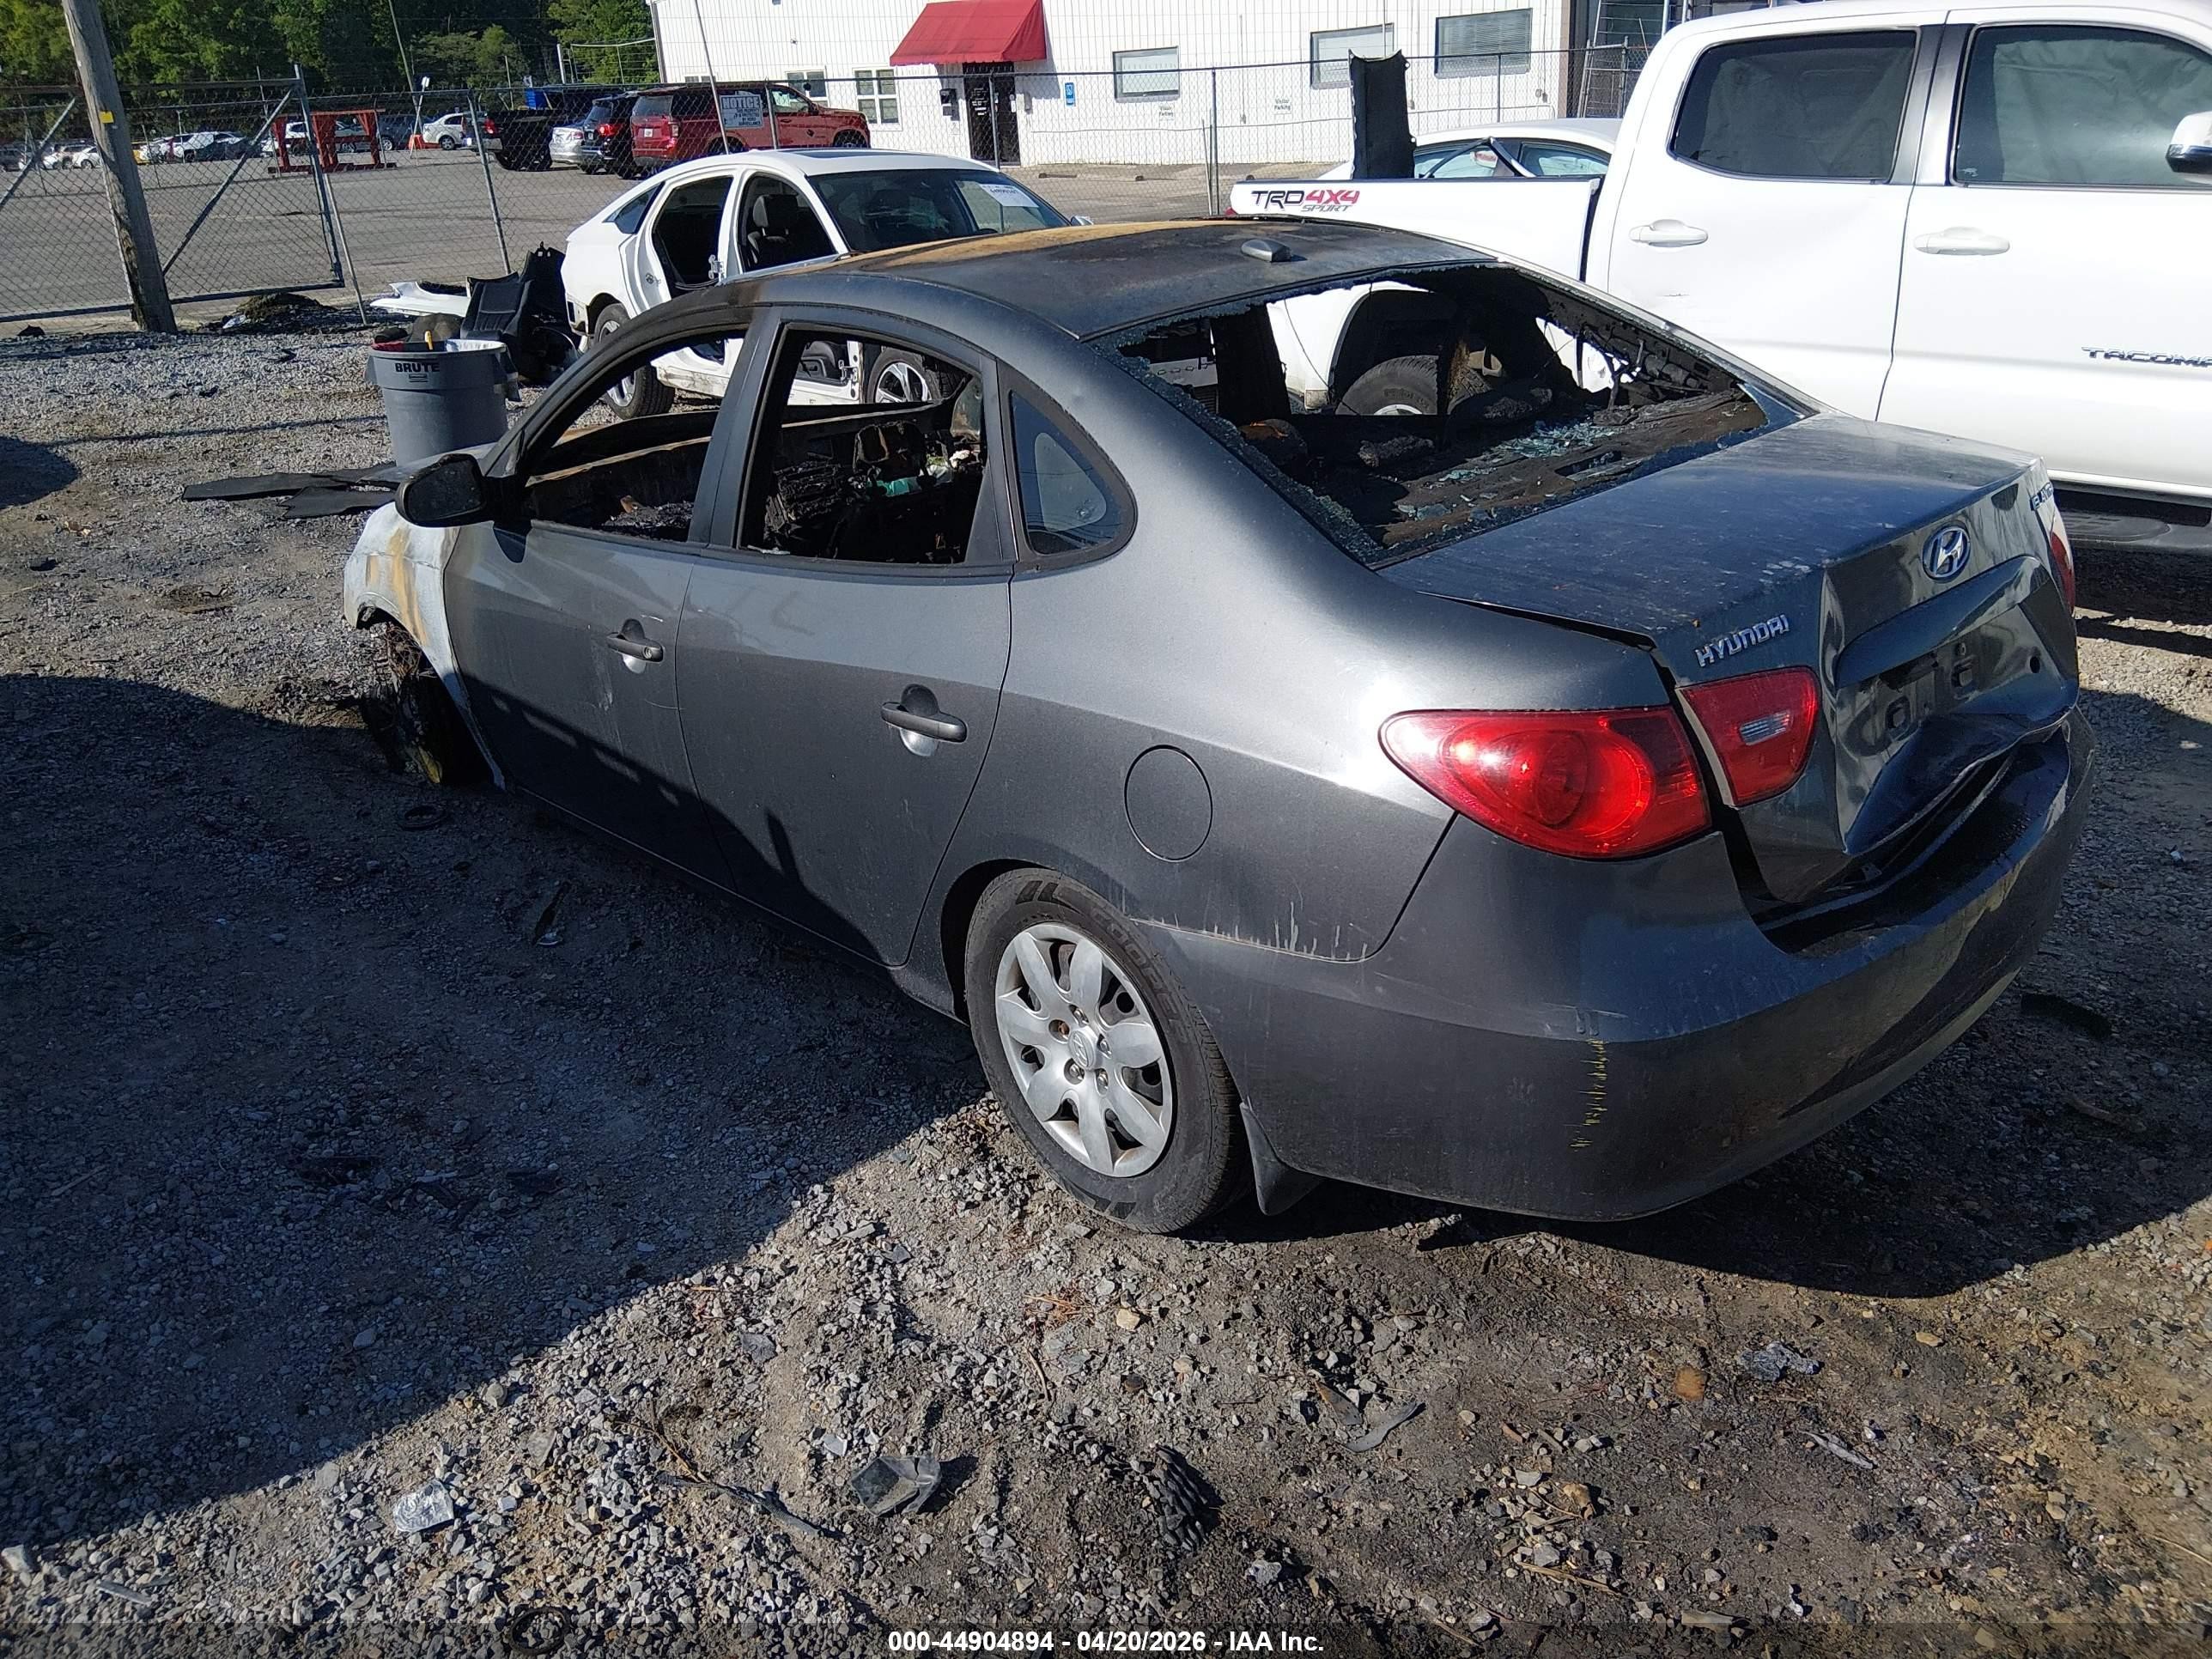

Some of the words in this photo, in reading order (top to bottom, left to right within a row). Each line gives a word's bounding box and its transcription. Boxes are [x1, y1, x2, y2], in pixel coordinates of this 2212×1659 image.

[722, 96, 760, 109] NOTICE
[1251, 190, 1305, 210] TRD
[395, 362, 440, 373] BRUTE
[1694, 614, 1790, 667] HYUNDAI
